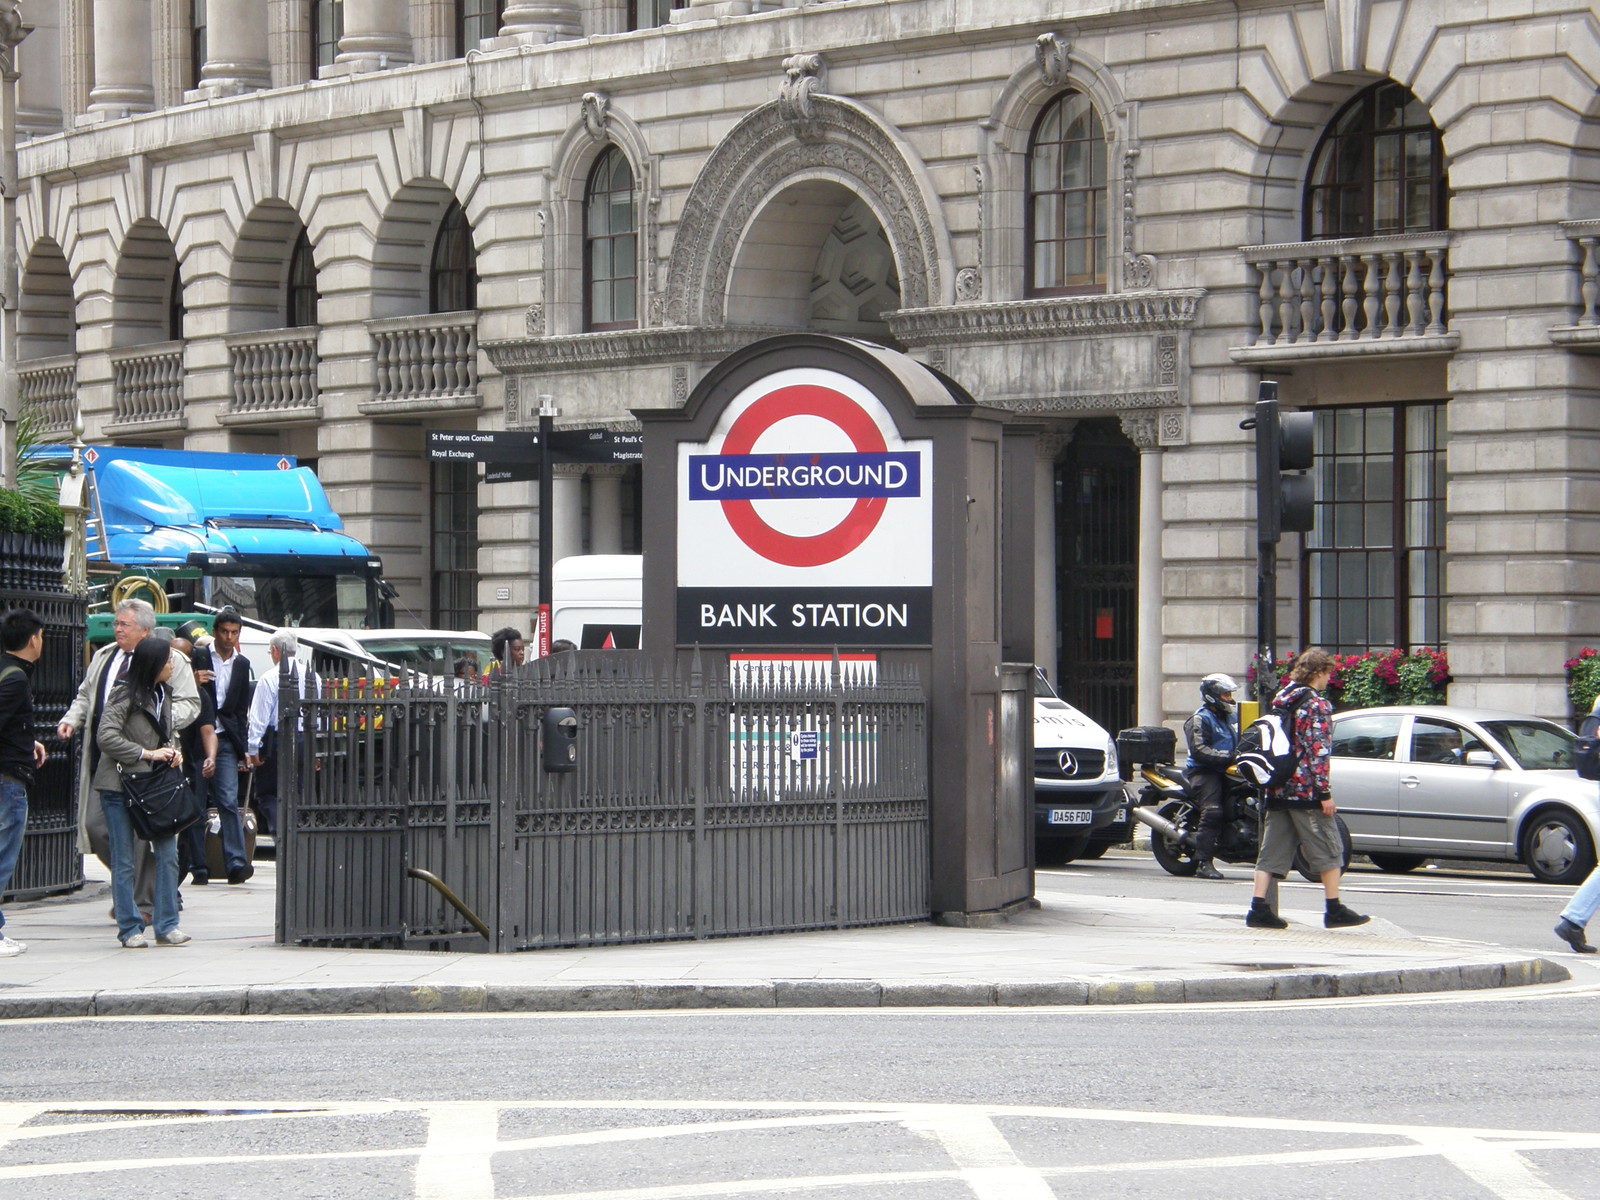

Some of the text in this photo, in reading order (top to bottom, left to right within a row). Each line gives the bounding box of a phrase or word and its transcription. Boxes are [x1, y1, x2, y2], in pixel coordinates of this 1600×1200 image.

[432, 433, 438, 441] St
[440, 433, 454, 441] Peter
[471, 434, 494, 442] Cornhill
[432, 450, 474, 459] Royal Exchange
[701, 461, 908, 491] UNDERGROUND
[701, 603, 908, 627] BANK STATION
[540, 638, 549, 656] gum
[1053, 811, 1075, 822] DA56
